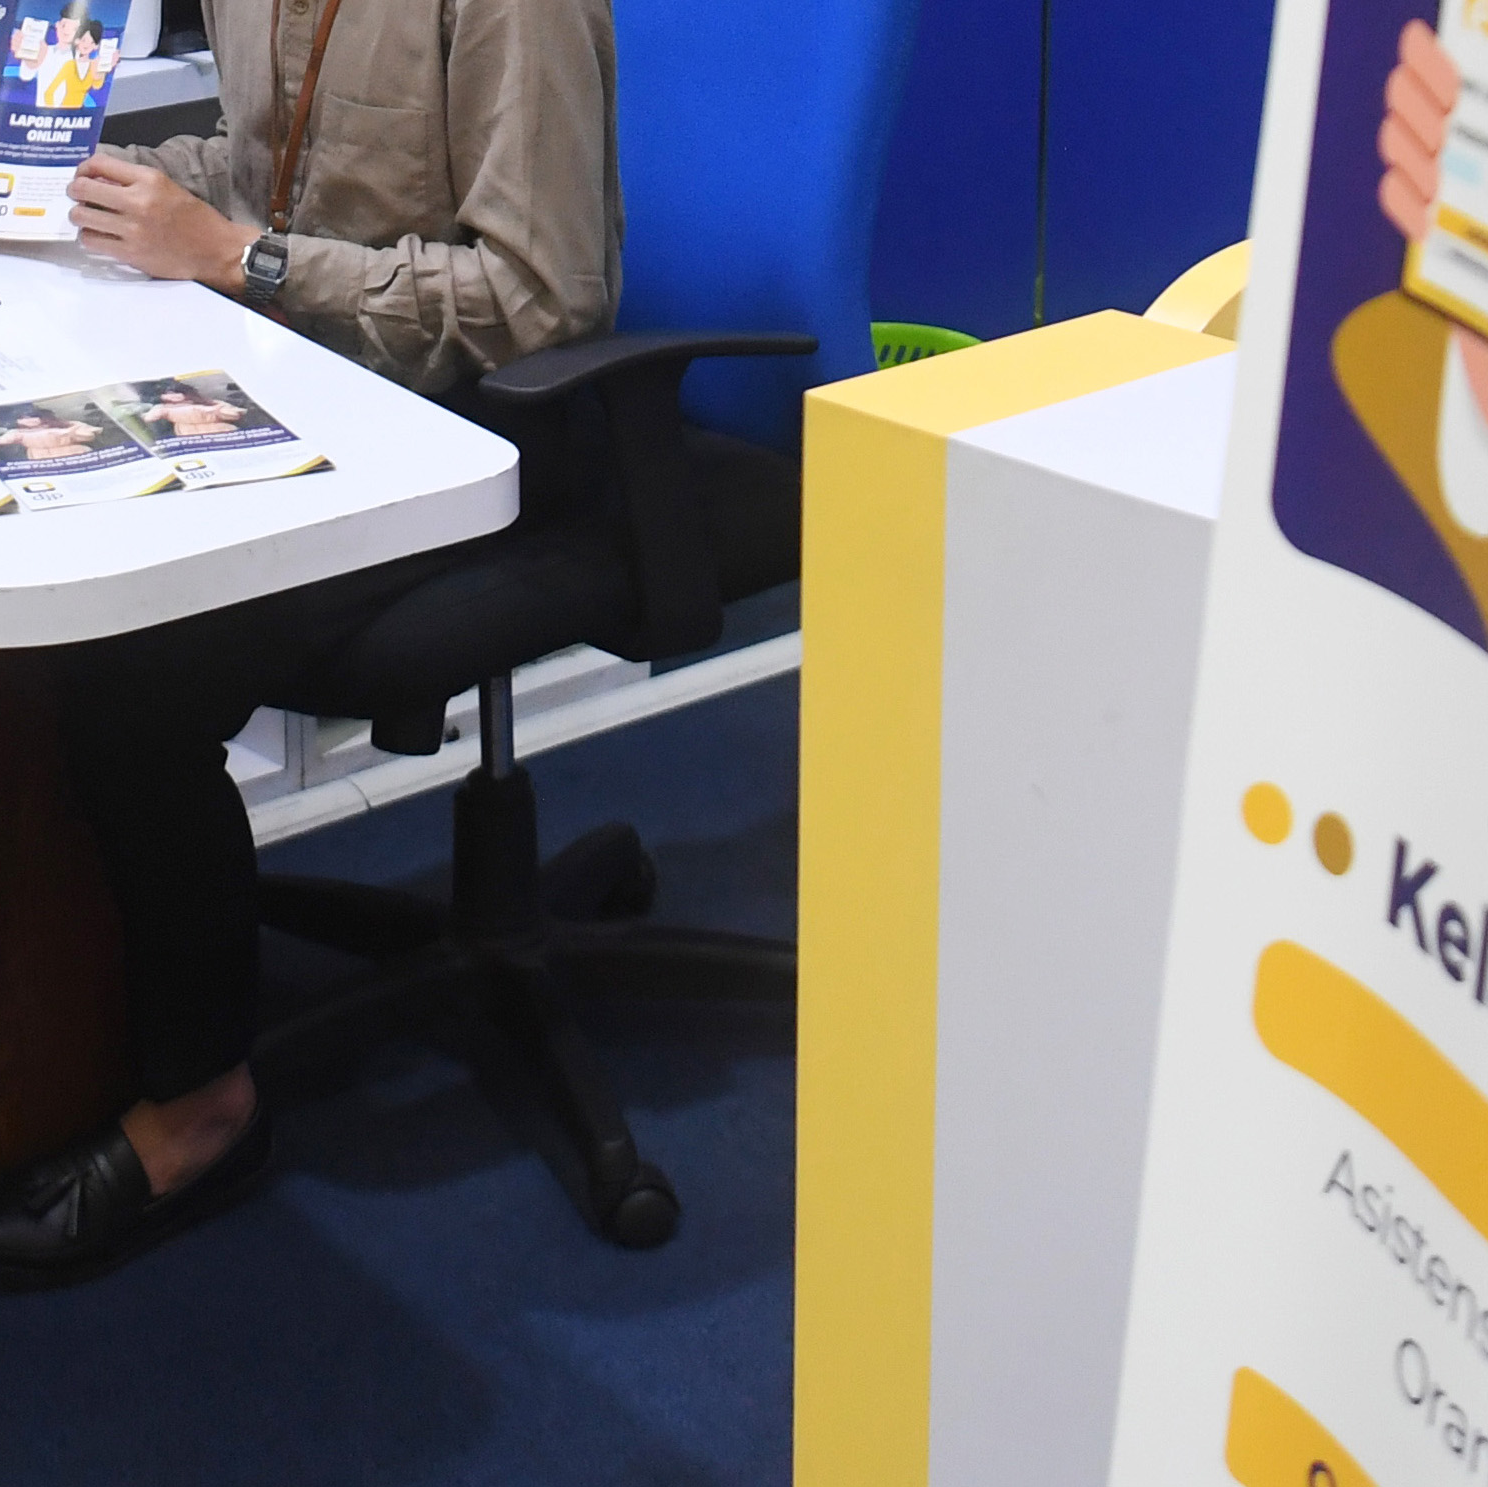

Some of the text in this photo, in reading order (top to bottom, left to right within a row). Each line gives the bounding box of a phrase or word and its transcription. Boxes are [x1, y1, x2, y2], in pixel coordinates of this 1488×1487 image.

[8, 112, 93, 130] LAPOR PAJAK
[26, 129, 73, 143] ONLINE
